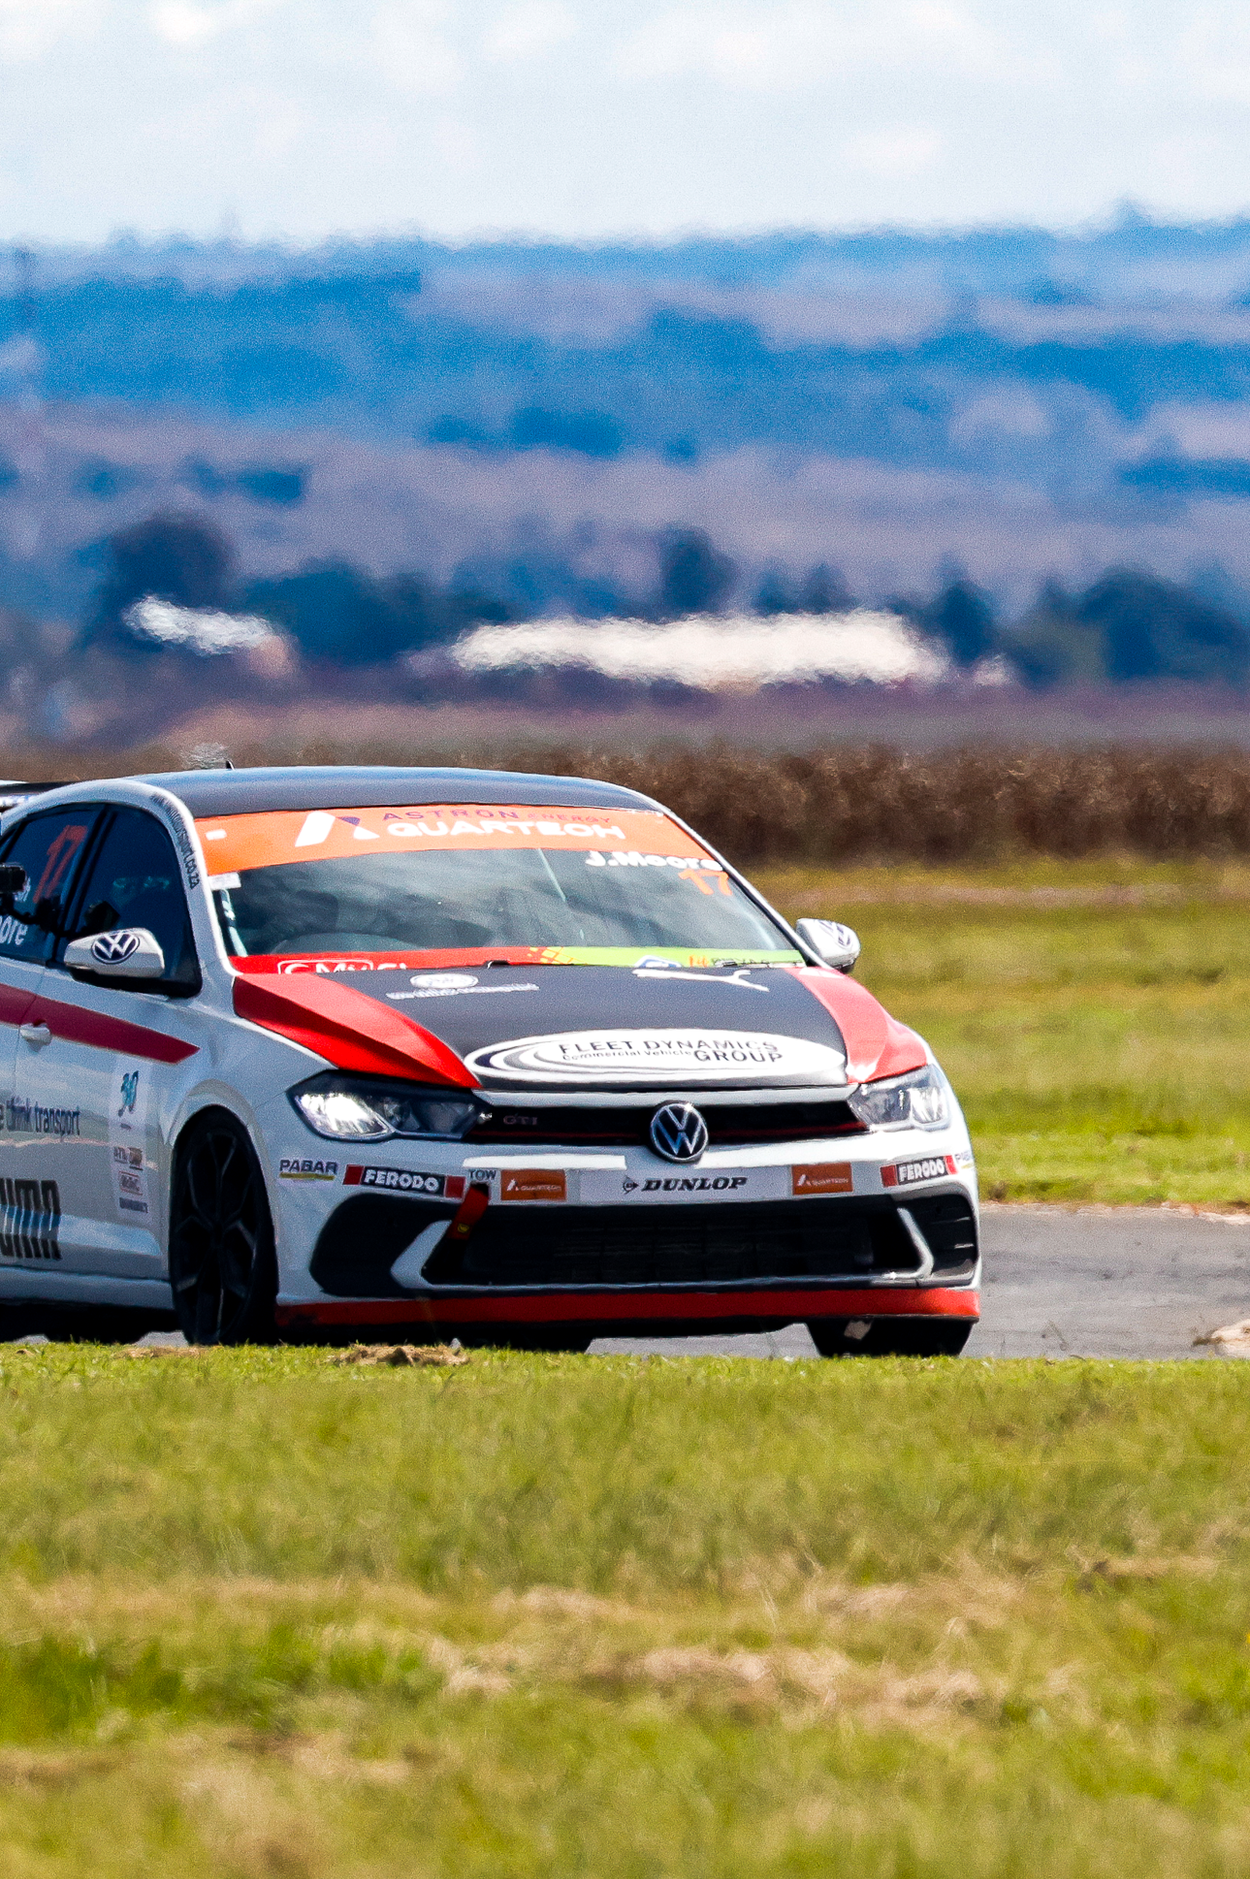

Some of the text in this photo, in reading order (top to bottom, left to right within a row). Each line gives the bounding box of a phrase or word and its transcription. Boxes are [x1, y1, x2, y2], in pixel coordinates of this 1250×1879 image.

[383, 809, 519, 821] ASTRON
[387, 820, 626, 840] QUARTECH
[678, 868, 733, 897] 17
[559, 1039, 779, 1054] FLEET DYNAMICS
[693, 1050, 783, 1063] GROUP
[34, 1102, 81, 1139] transport
[502, 1115, 538, 1126] GTI
[278, 1158, 339, 1175] PABAR
[899, 1163, 946, 1182] FERODO
[363, 1169, 441, 1192] FERODO
[468, 1169, 497, 1182] TOW
[641, 1175, 748, 1192] DUNLOP
